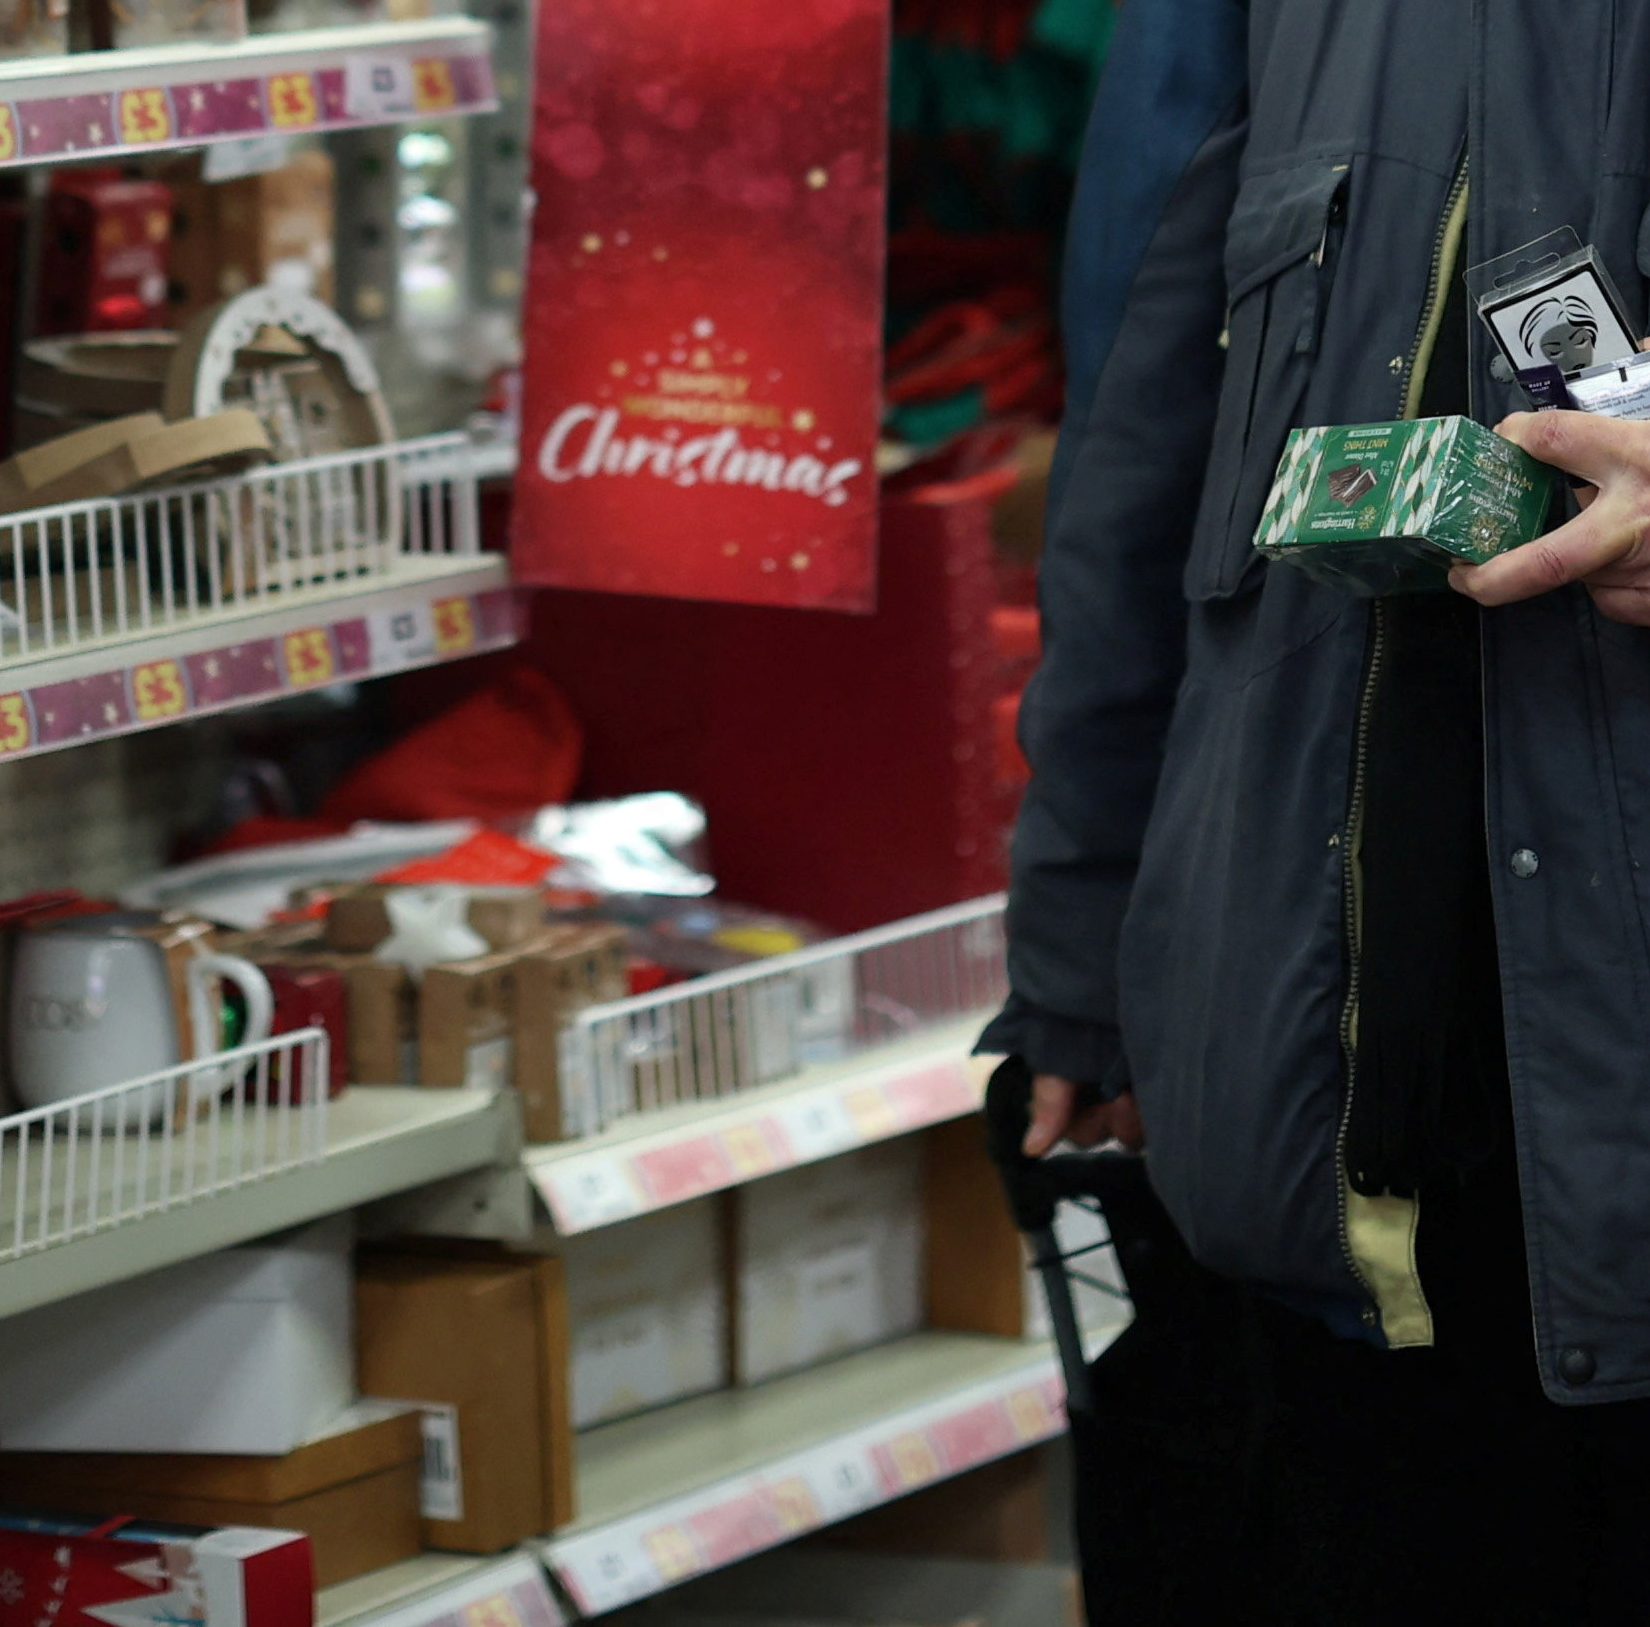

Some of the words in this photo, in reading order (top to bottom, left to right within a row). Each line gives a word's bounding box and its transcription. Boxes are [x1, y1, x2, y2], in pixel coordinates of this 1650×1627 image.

[119, 87, 171, 144] £3
[270, 73, 317, 127] £3
[537, 402, 863, 507] Christmas
[1310, 517, 1357, 531] Harringtons
[283, 629, 335, 686] £3
[131, 660, 185, 721] £3
